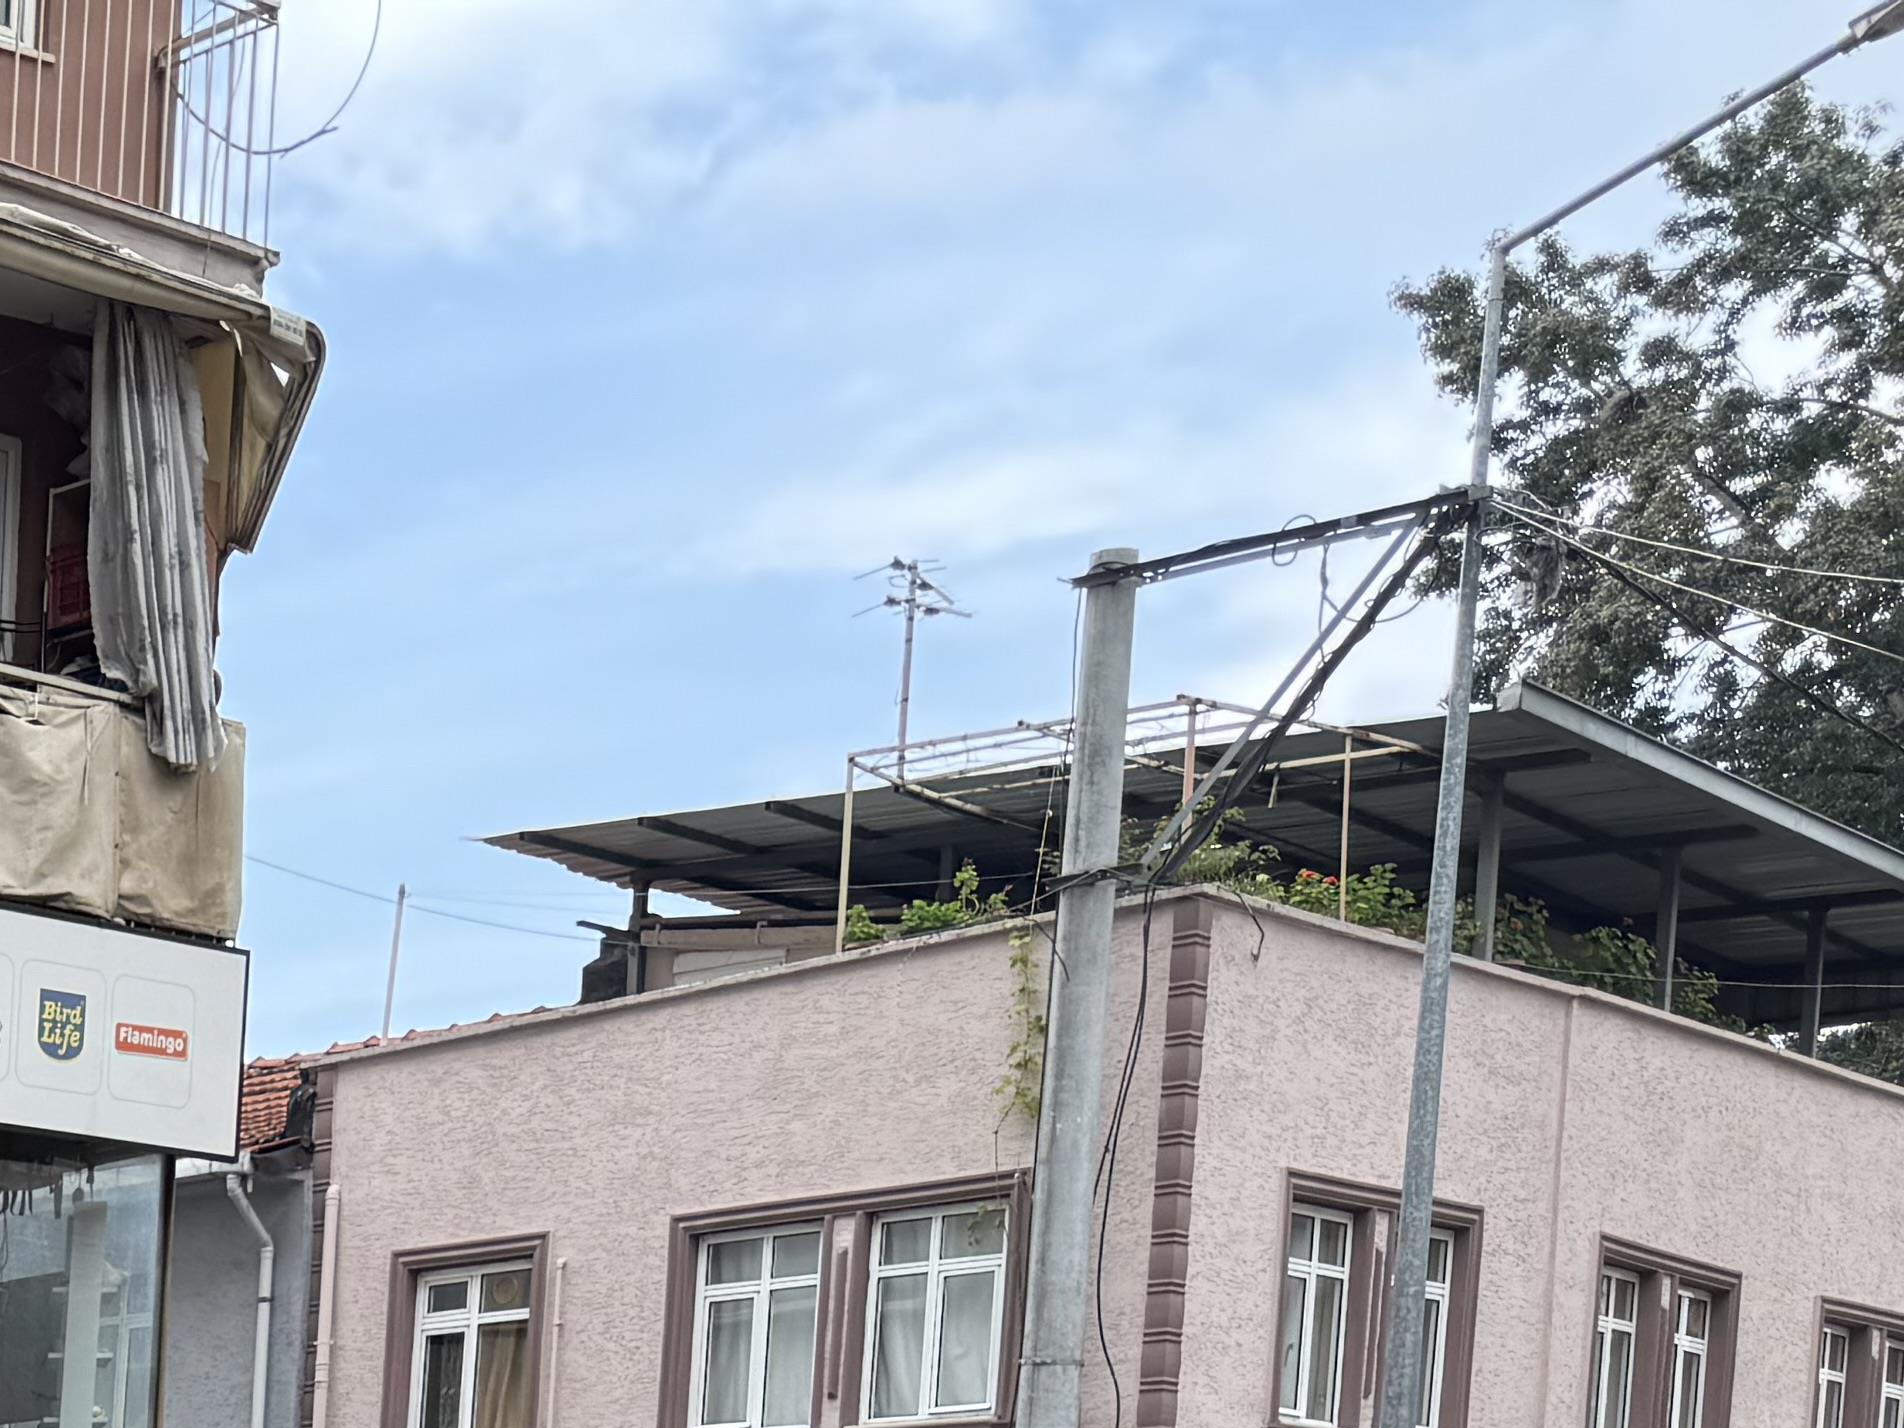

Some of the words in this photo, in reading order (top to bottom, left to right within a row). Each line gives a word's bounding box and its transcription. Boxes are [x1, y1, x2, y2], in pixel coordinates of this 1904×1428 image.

[41, 1000, 83, 1024] Bird
[41, 1021, 82, 1056] Life
[118, 1025, 185, 1053] Flamingo
